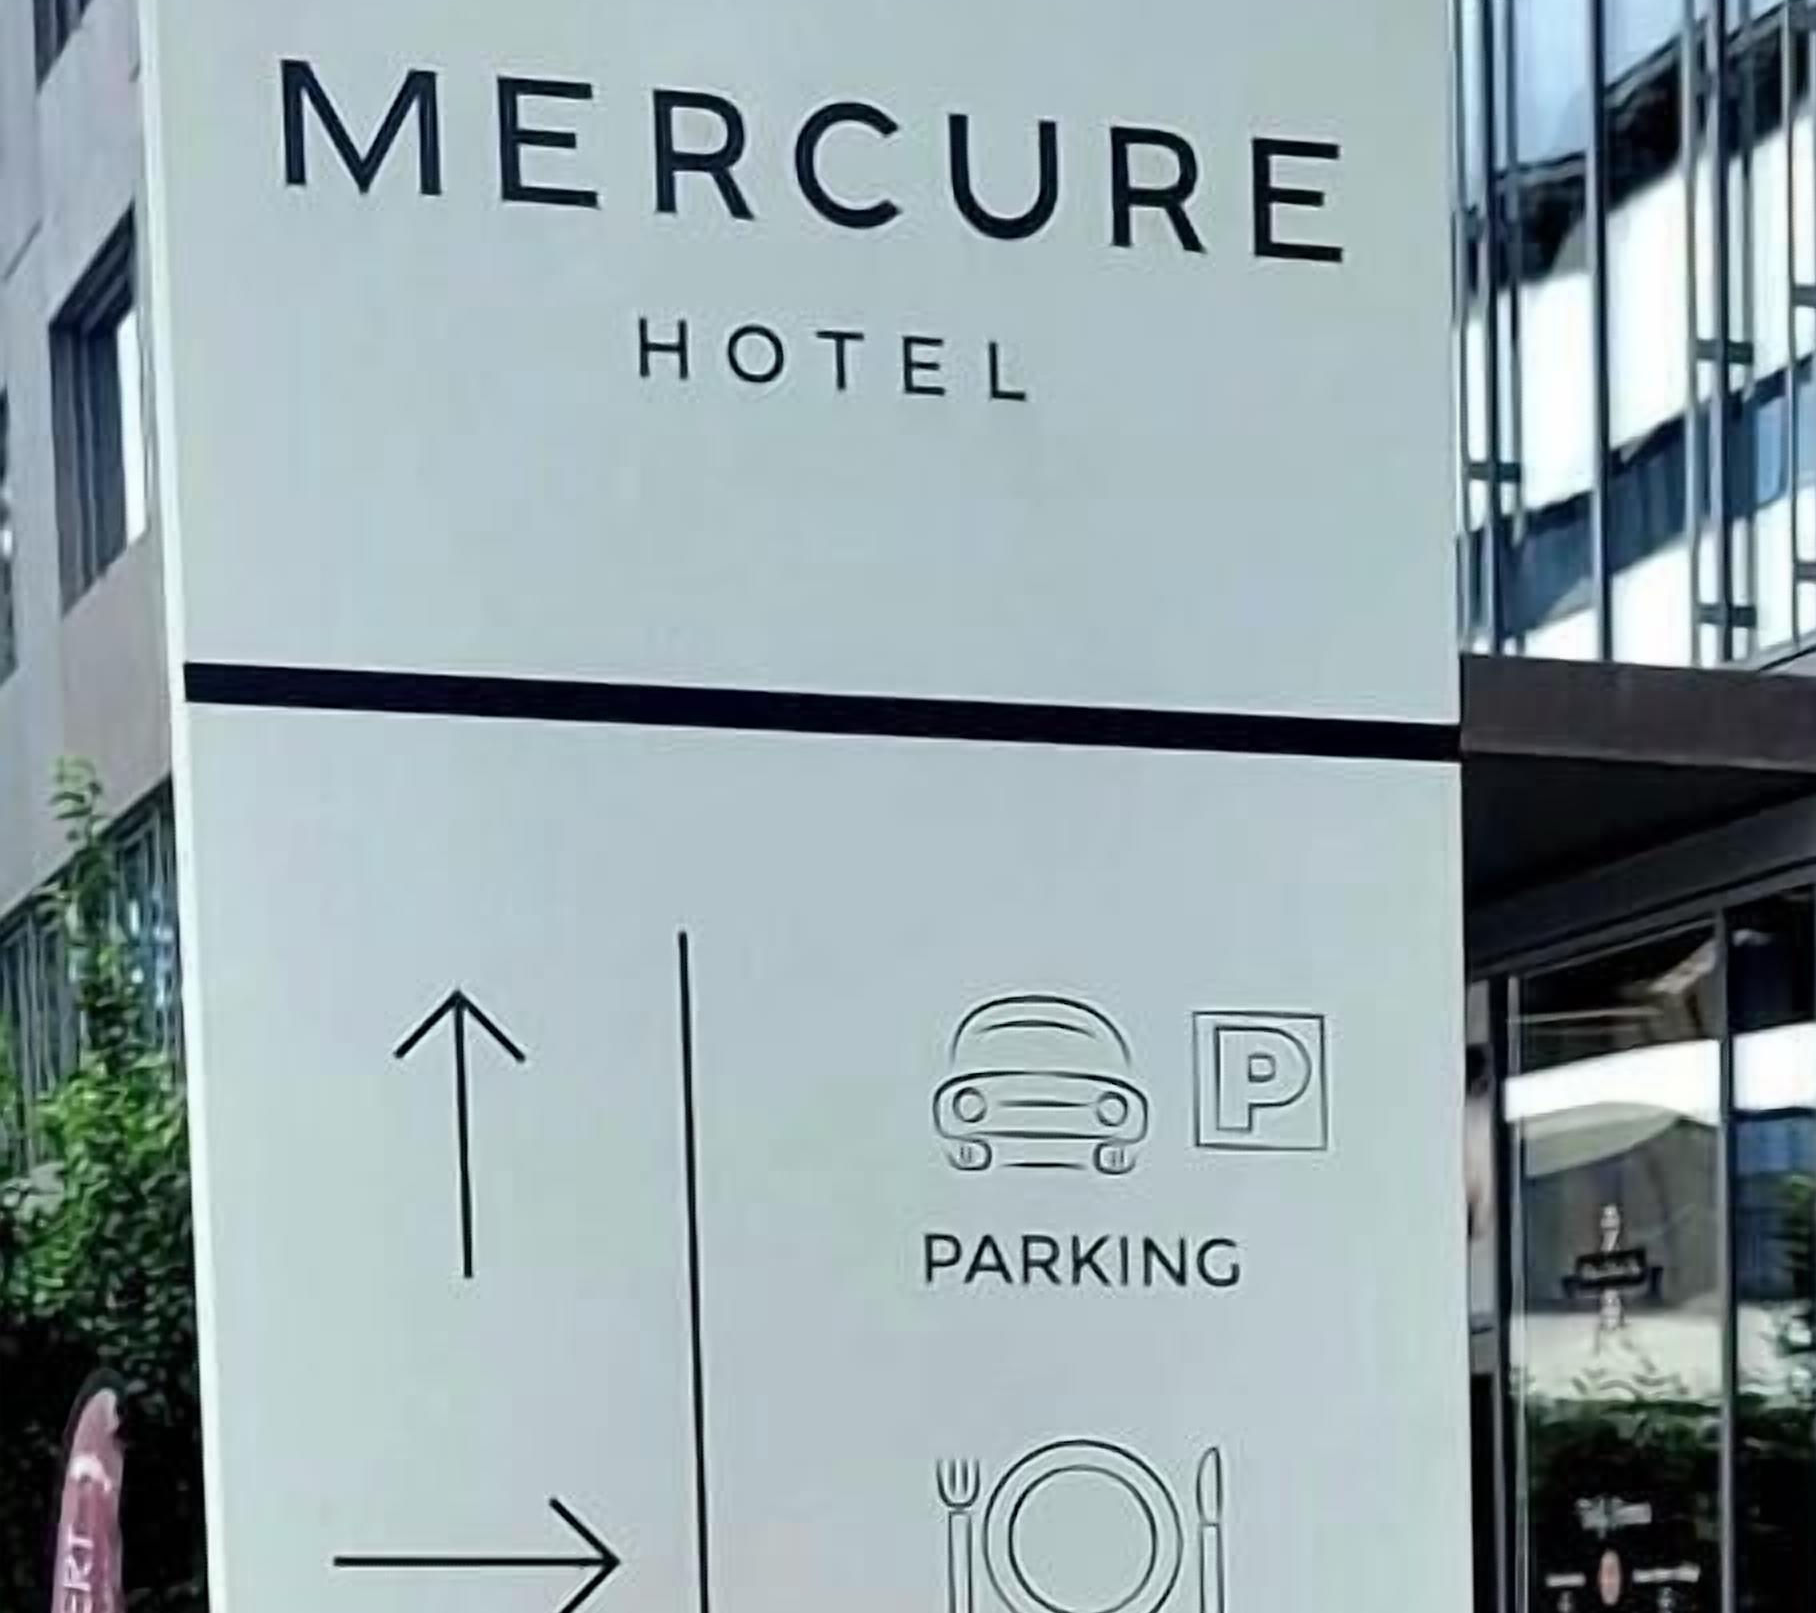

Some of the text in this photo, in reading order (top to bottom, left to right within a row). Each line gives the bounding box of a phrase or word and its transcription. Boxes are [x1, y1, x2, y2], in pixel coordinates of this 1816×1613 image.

[278, 57, 1345, 265] MERCURE
[637, 316, 1028, 402] HOTEL
[923, 1232, 1243, 1288] PARKING
